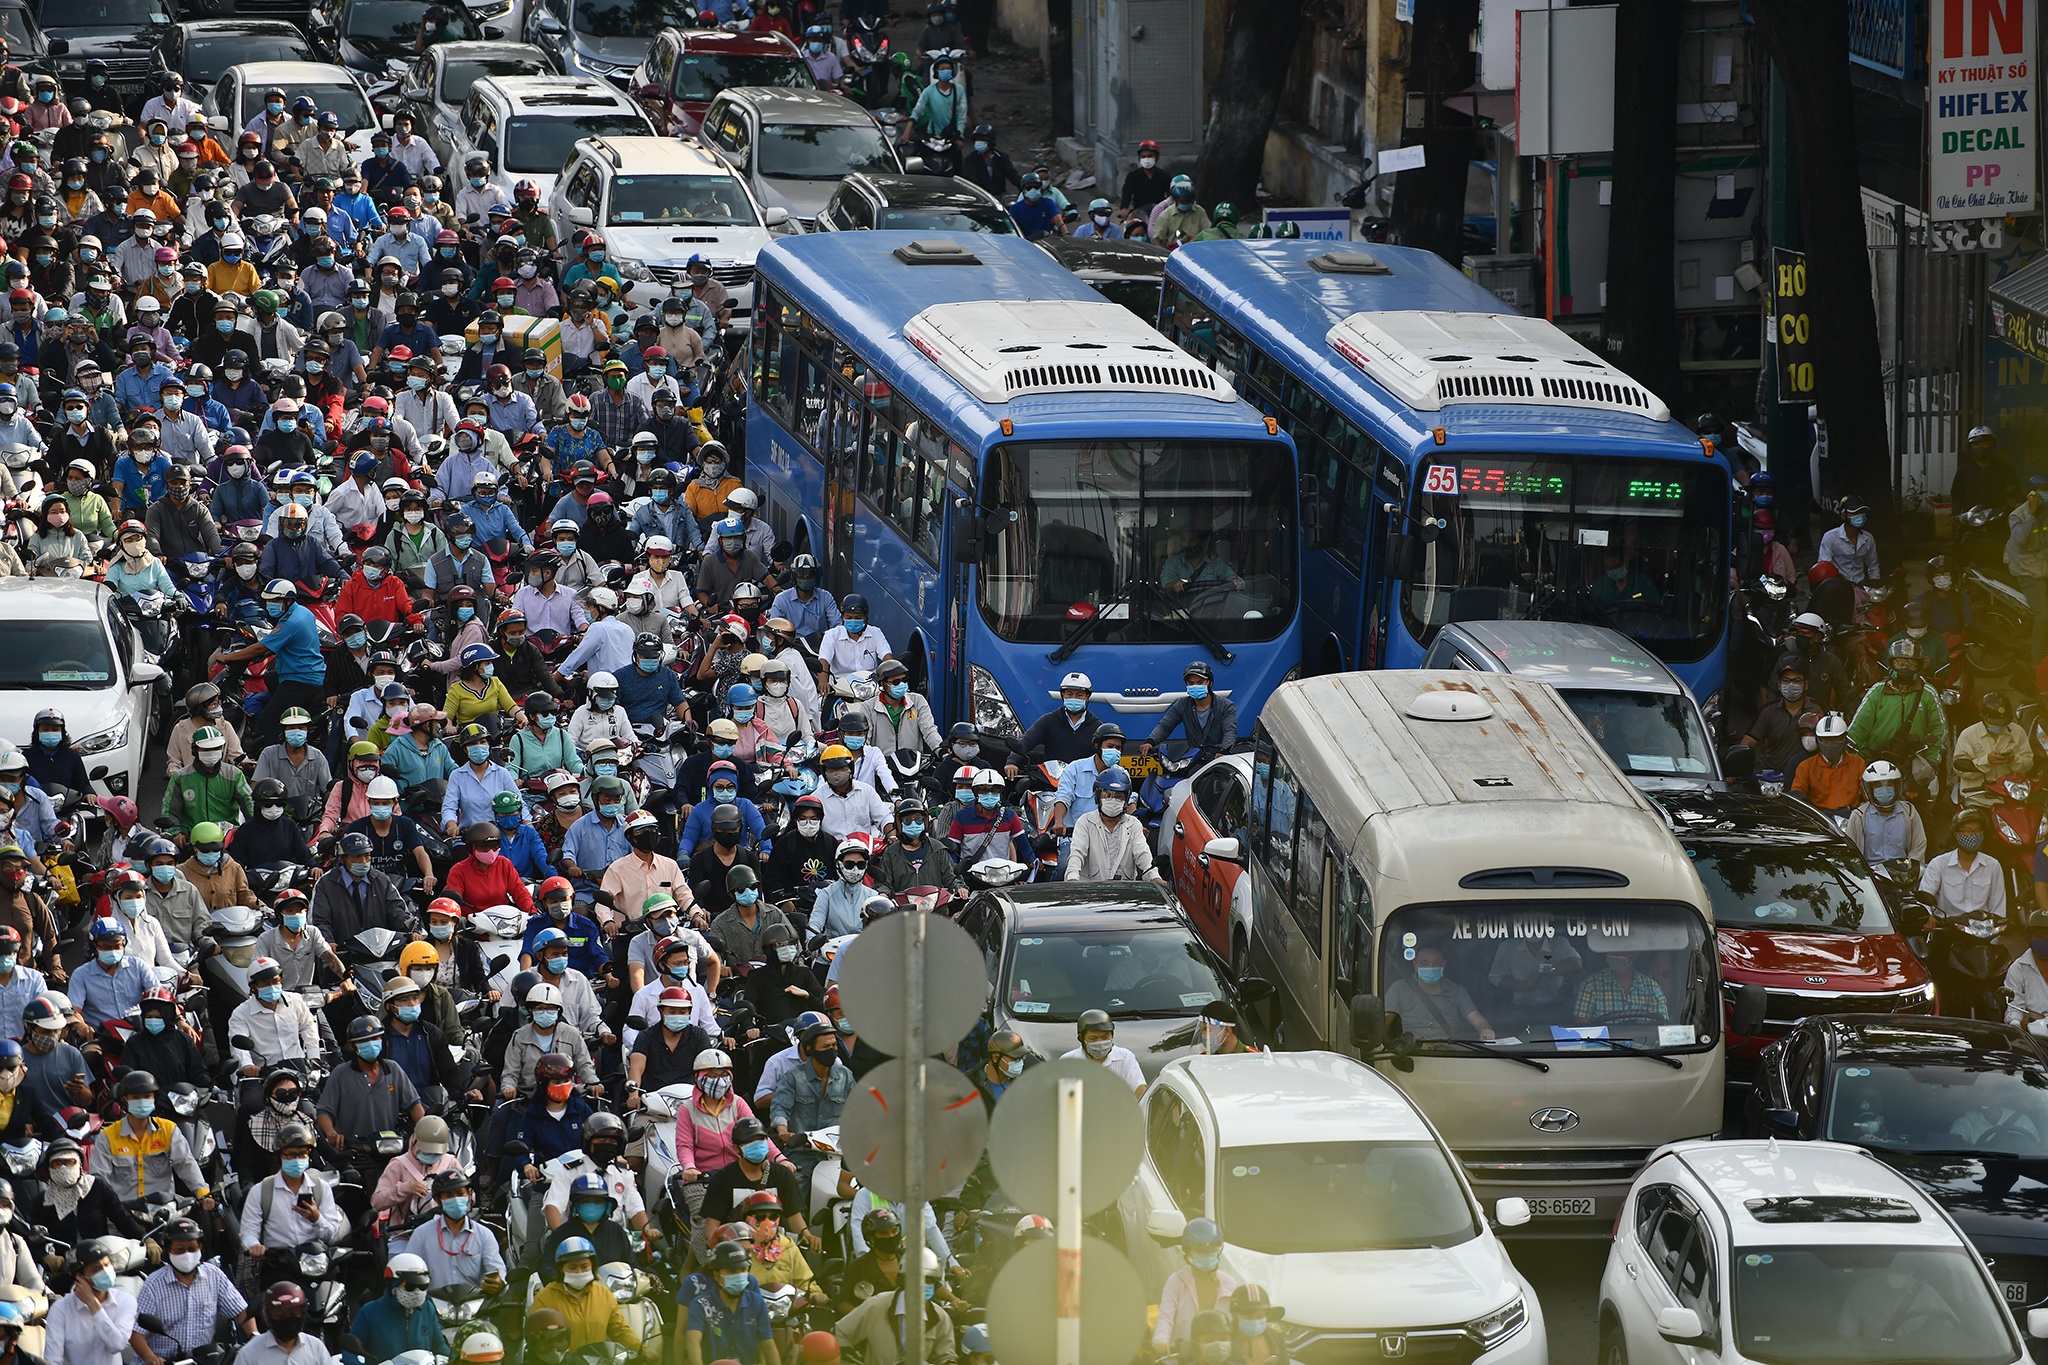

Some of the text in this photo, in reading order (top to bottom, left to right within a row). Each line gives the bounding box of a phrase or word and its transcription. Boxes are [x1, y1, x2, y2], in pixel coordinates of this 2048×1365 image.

[1944, 0, 2023, 58] IN
[1938, 60, 2027, 83] KỸ THUẬT SỐ
[1939, 90, 2028, 118] HIFLEX
[1942, 126, 2025, 154] DECAL
[1966, 164, 2001, 187] PP
[1937, 191, 2028, 209] Và Các Chất Liệu Khác
[1787, 361, 1815, 393] 10
[1428, 467, 1455, 491] 55
[1124, 687, 1159, 696] SAMCO
[371, 854, 404, 864] TIHAD
[1452, 913, 1473, 939] XE
[1566, 913, 1587, 936] CB
[1601, 913, 1630, 937] CNV
[1808, 976, 1824, 984] KIA
